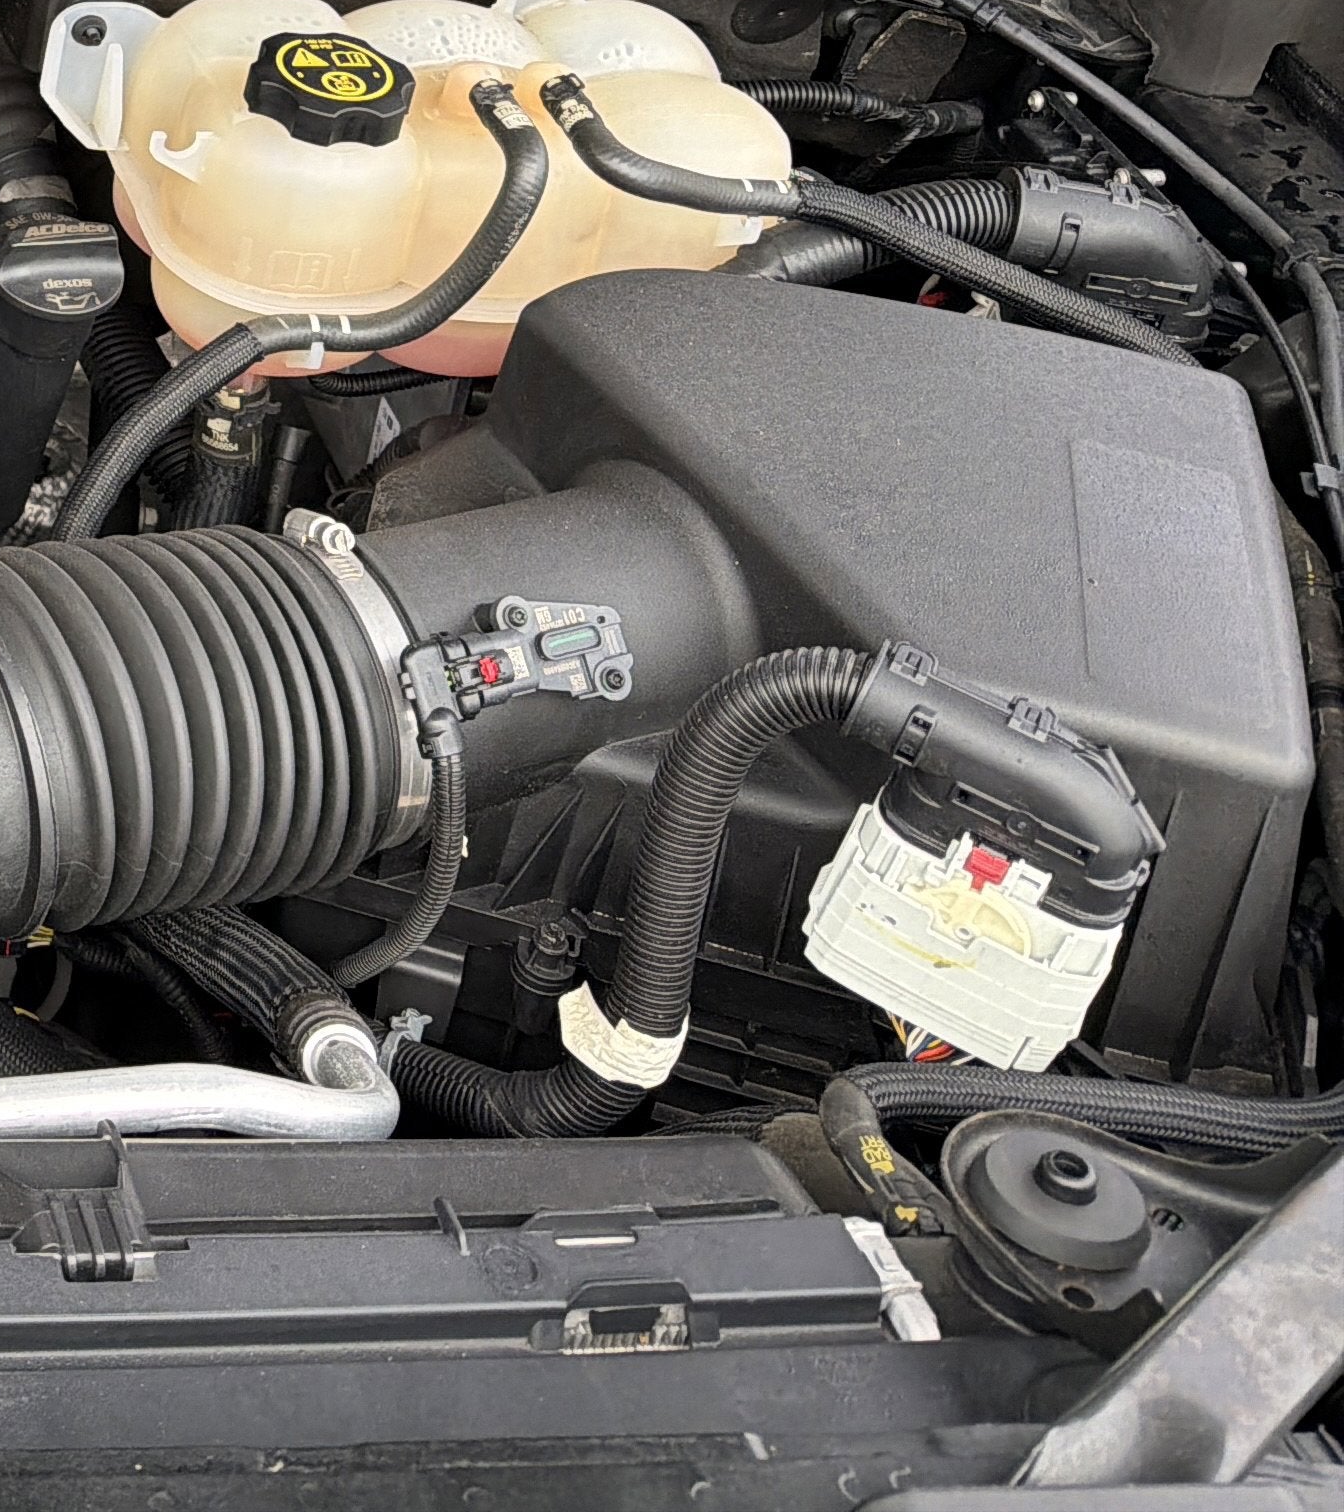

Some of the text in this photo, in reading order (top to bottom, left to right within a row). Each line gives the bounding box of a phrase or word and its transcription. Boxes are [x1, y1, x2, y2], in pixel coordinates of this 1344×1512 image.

[5, 215, 28, 230] SAE
[23, 222, 110, 238] ACDelco
[42, 278, 93, 290] dexos
